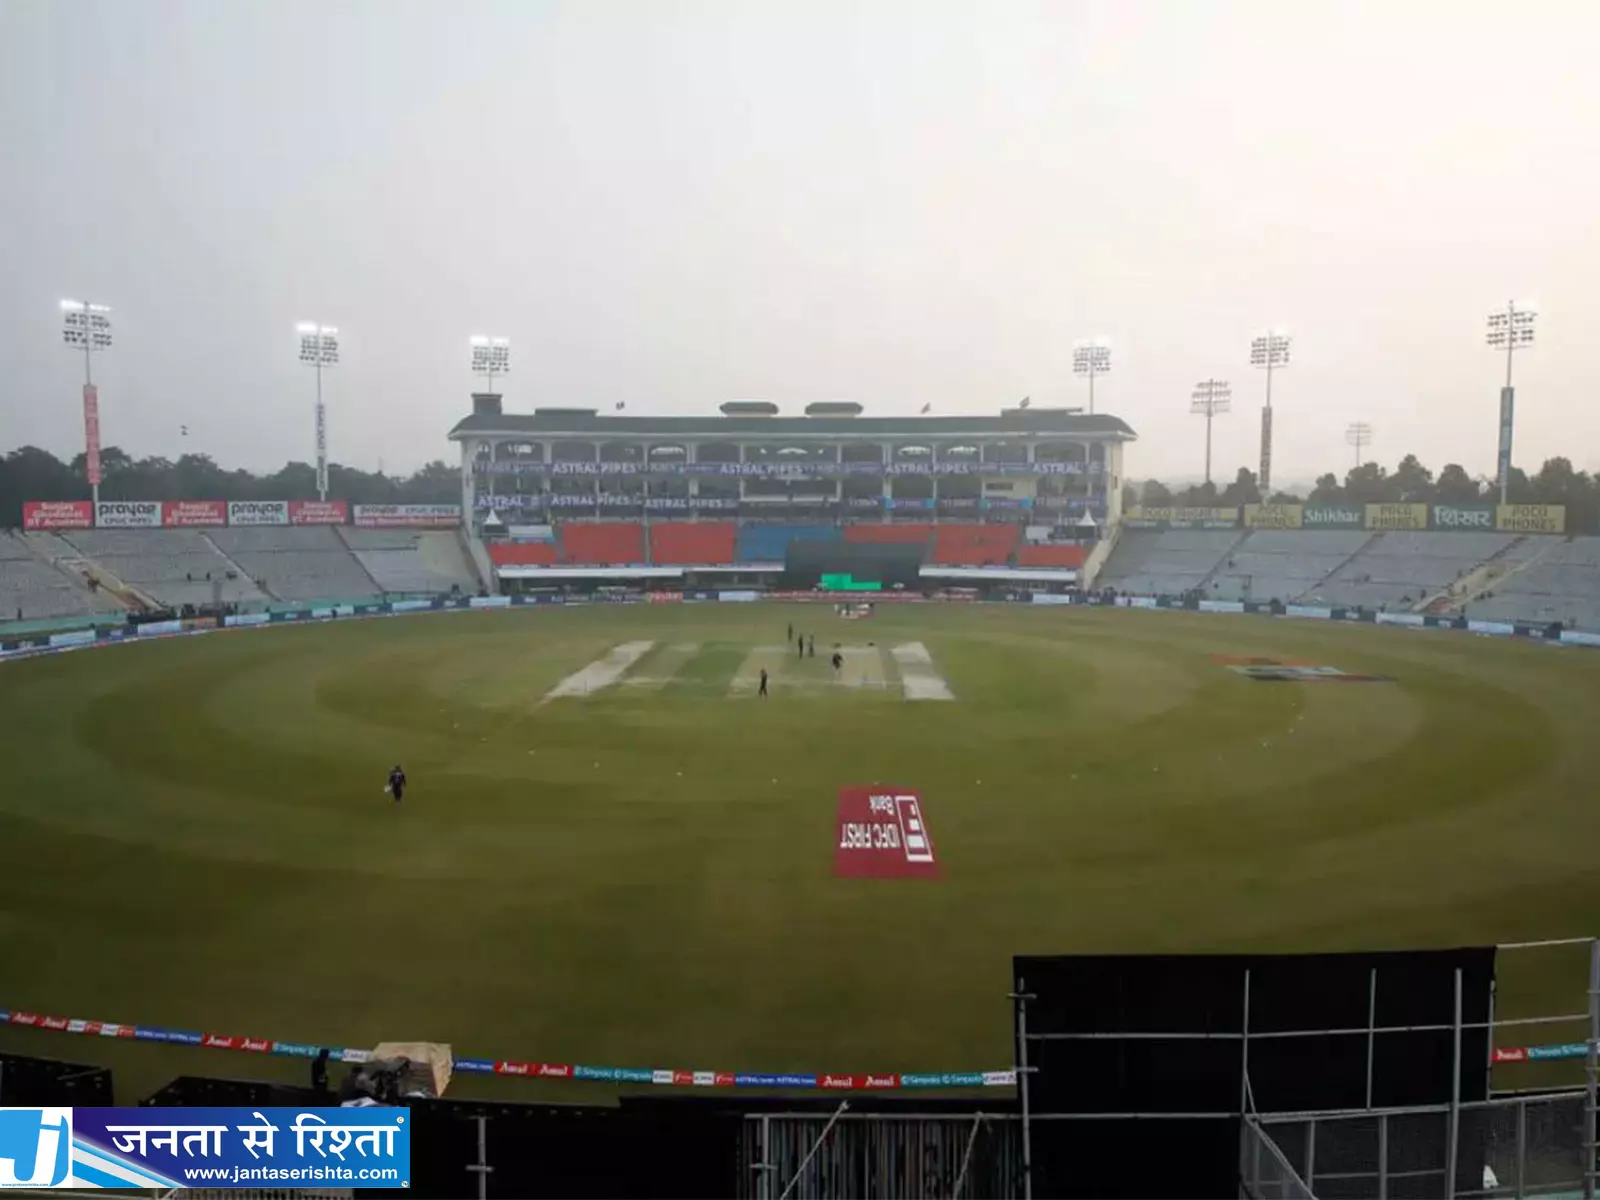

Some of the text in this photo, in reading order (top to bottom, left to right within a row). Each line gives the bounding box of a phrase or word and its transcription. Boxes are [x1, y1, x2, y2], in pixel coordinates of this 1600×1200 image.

[552, 463, 598, 474] ASTRAL
[600, 463, 637, 474] PIPES
[720, 464, 765, 475] ASTRAL
[885, 463, 931, 474] ASTRAL
[934, 463, 969, 474] PIPES
[1032, 463, 1083, 474] ASTRAL
[552, 495, 594, 505] ASTRAL
[645, 499, 722, 509] ASTRAL PIPES
[1305, 508, 1360, 523] Shikhar
[1380, 504, 1412, 515] POCO
[1512, 506, 1547, 517] POCO
[1371, 516, 1420, 527] PHONES
[1433, 506, 1491, 526] शिखर
[1502, 517, 1556, 530] PHONES
[840, 823, 900, 848] IDFC FIRST
[206, 1035, 232, 1047] Amul
[241, 1038, 268, 1050] Amul
[502, 1062, 528, 1074] Amul
[540, 1064, 568, 1076] Amul
[823, 1075, 852, 1087] Amul
[865, 1075, 894, 1087] Amul
